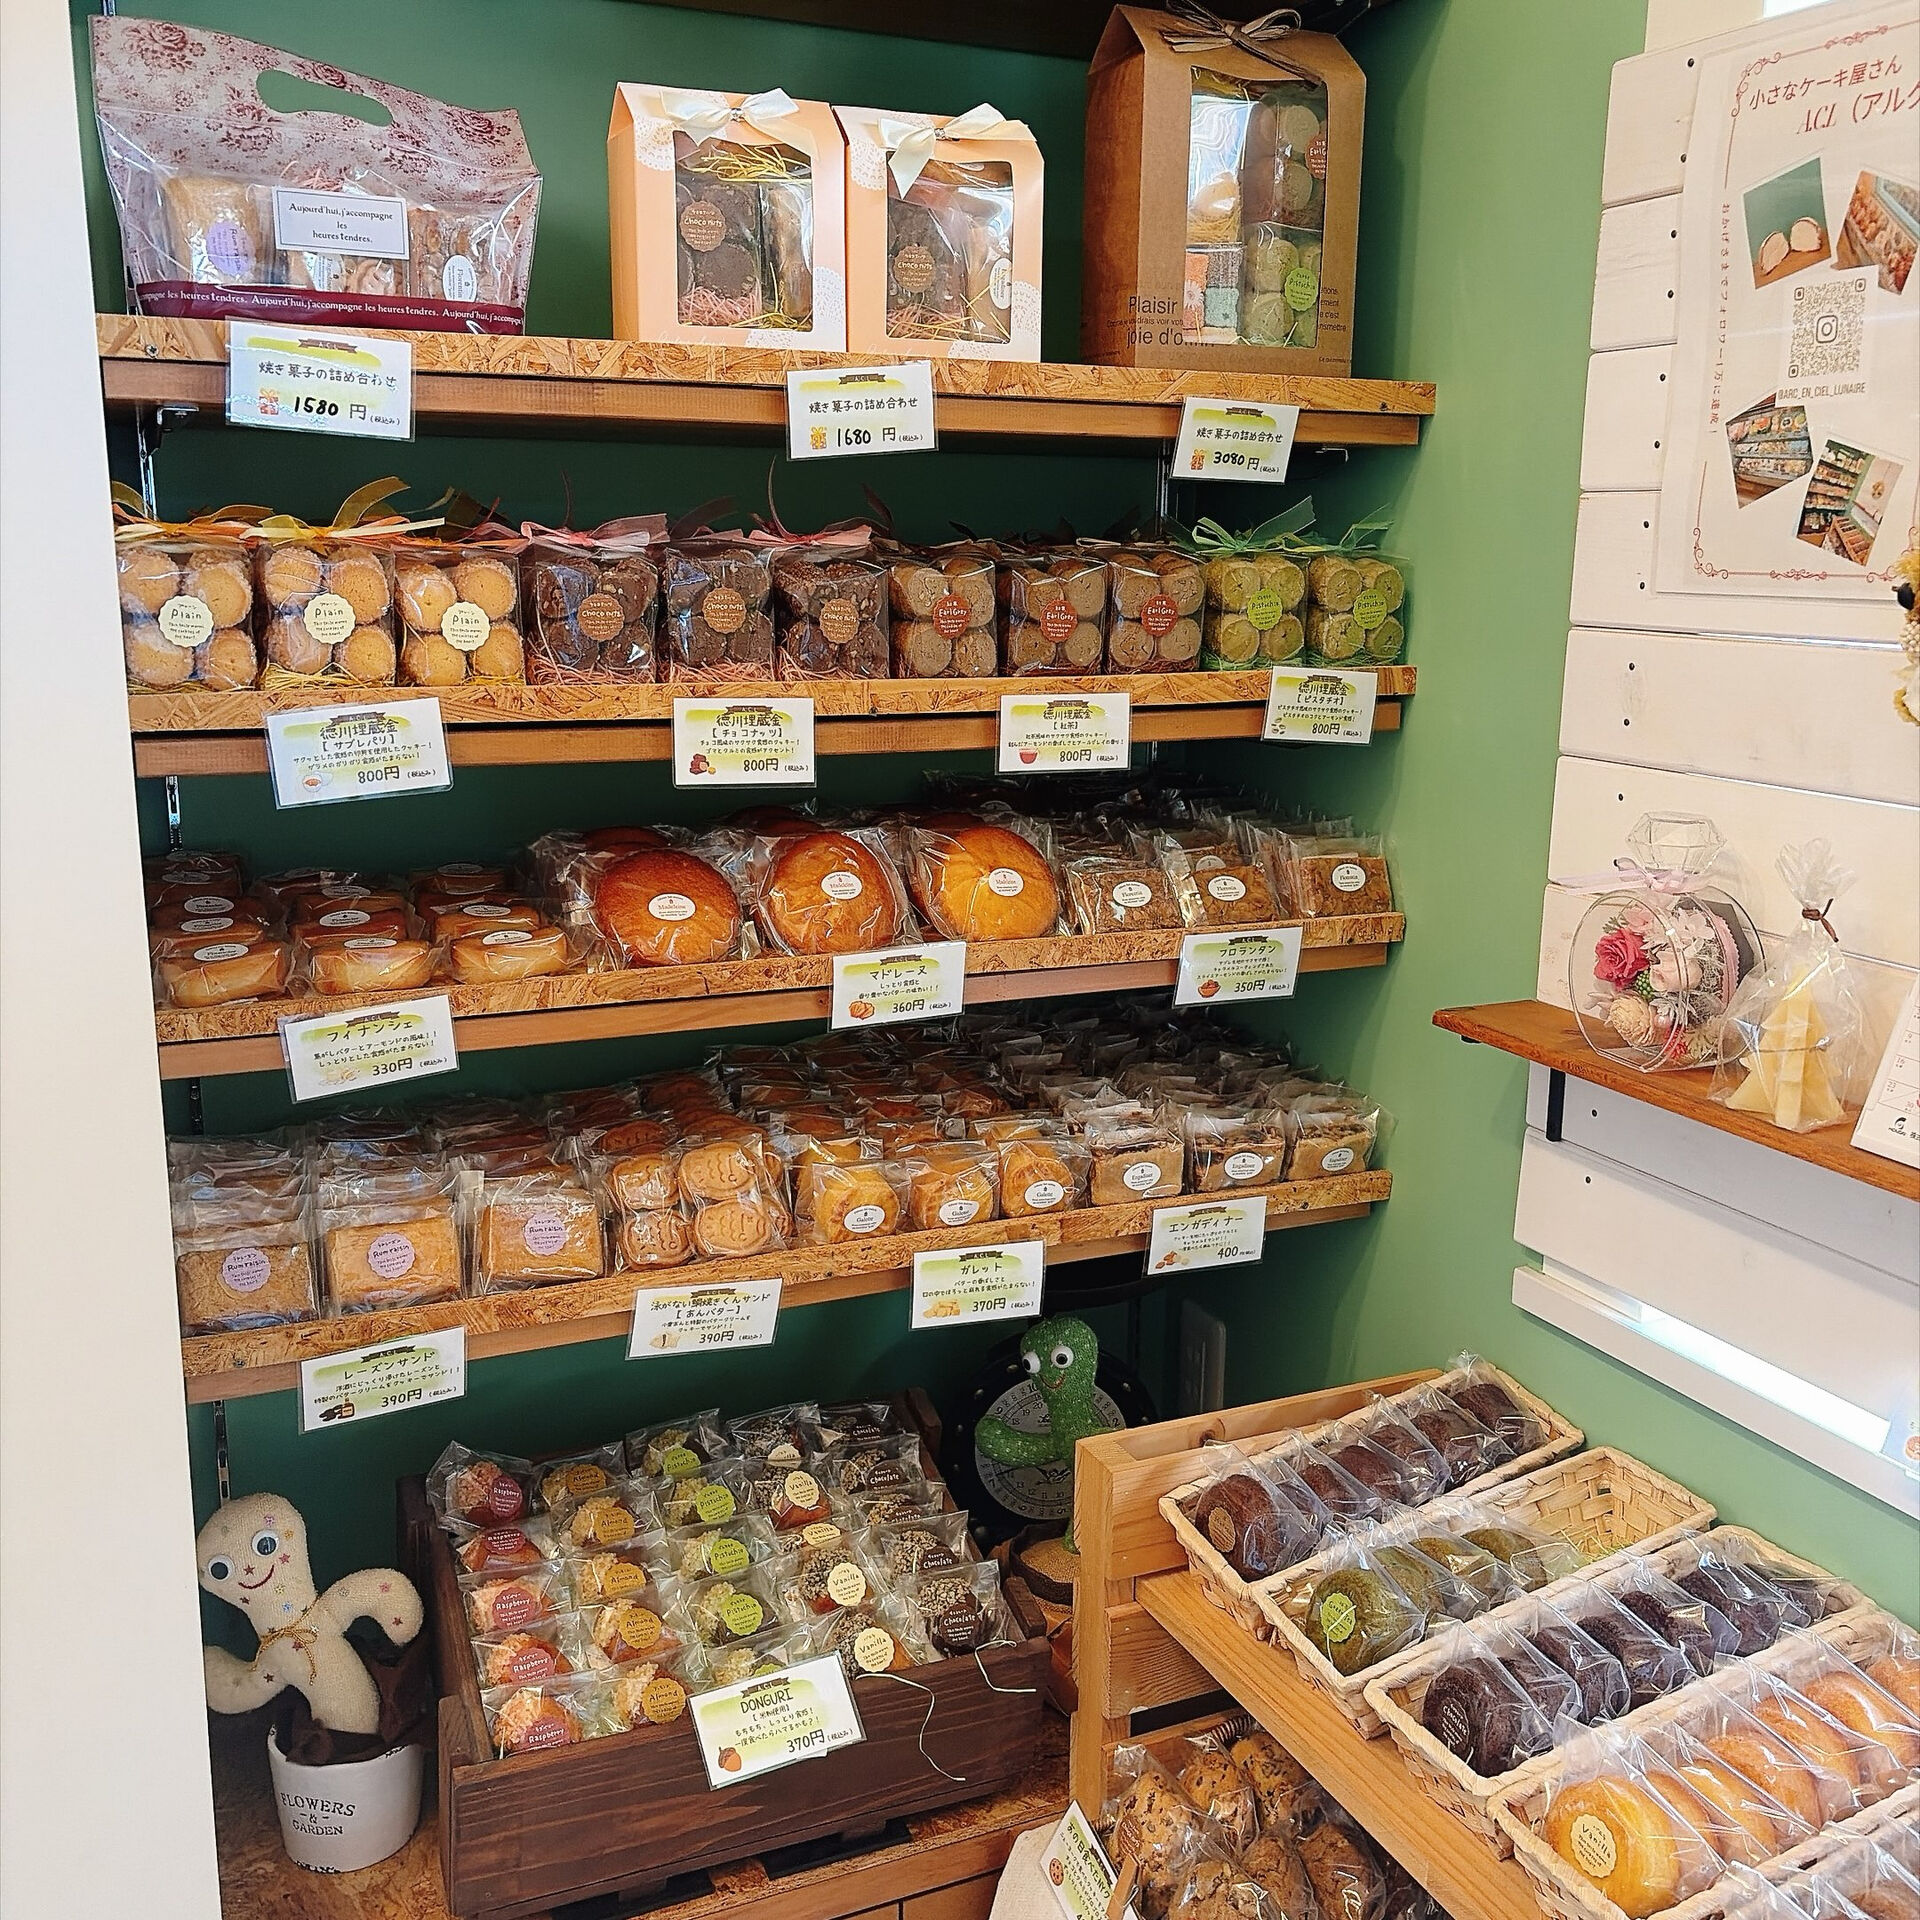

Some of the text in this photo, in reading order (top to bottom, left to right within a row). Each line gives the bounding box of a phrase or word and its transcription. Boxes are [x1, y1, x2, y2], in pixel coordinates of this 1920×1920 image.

[1750, 54, 1902, 110] 小さなケーキ屋さん
[336, 221, 348, 229] les
[312, 230, 373, 243] heures tendres.
[167, 290, 179, 299] les
[180, 290, 210, 301] heures
[210, 292, 248, 303] tendres.
[364, 302, 376, 312] les
[378, 303, 405, 314] heures
[405, 306, 439, 317] tendres.
[1128, 296, 1178, 315] Plaisir
[1126, 326, 1153, 349] joie
[258, 361, 398, 392] 焼き菓子の詰め合わせ
[293, 396, 339, 417] 1580
[349, 403, 367, 421] 円
[809, 397, 918, 414] 焼き菓子の詰め合わせ
[837, 428, 872, 448] 1680
[882, 427, 896, 442] 円
[1196, 427, 1284, 443] 焼き菓子の詰め合わせ
[1213, 451, 1245, 466] 3080
[1246, 457, 1260, 470] 円
[171, 608, 202, 620] Plain
[314, 607, 344, 618] Plain
[452, 614, 480, 625] Plain
[1298, 681, 1350, 696] 徳川埋蔵金
[716, 714, 783, 728] 徳川埋蔵金
[1043, 708, 1094, 721] 徳川埋蔵金
[320, 718, 399, 740] 徳川埋蔵金
[1312, 722, 1340, 735] 800円
[1059, 748, 1092, 763] 800円
[743, 757, 779, 772] 800円
[357, 765, 400, 784] 800円
[1219, 945, 1276, 958] フロランタン
[870, 965, 928, 981] マドレーヌ
[1234, 979, 1266, 993] 350円
[892, 999, 925, 1014] 360円
[327, 1020, 413, 1043] フィナンシェ
[372, 1057, 413, 1077] 330円
[528, 1226, 543, 1234] Rum
[1169, 1215, 1243, 1233] エンガディナー
[372, 1245, 410, 1259] Rum raisin
[1217, 1246, 1239, 1259] 400
[227, 1259, 266, 1272] Rum raisin
[961, 1262, 1002, 1275] ガレット
[972, 1297, 1006, 1312] 370円
[699, 1330, 735, 1344] 390円
[344, 1352, 436, 1380] レーズンサンド
[381, 1388, 423, 1408] 390円
[852, 1425, 881, 1437] Chocolate
[789, 1478, 813, 1490] Vanilla
[869, 1473, 900, 1485] Chocolate
[699, 1492, 729, 1509] Pistachio
[600, 1517, 628, 1527] Almond
[807, 1526, 834, 1537] Vanilla
[714, 1548, 744, 1560] Pistachio
[923, 1556, 953, 1570] Chocolate
[610, 1574, 639, 1585] Almond
[832, 1573, 860, 1586] Vanilla
[495, 1597, 531, 1611] Raspberry
[726, 1602, 757, 1616] Pistachio
[626, 1616, 655, 1628] Almond
[943, 1612, 976, 1627] Chocolate
[858, 1636, 887, 1654] Vanilla
[513, 1656, 549, 1673] Raspberry
[649, 1689, 679, 1703] Almond
[740, 1687, 794, 1714] DONGURI
[528, 1727, 565, 1744] Raspberry
[786, 1728, 825, 1753] 370円
[280, 1792, 356, 1817] FLOWERS
[292, 1819, 343, 1836] GARDEN
[1581, 1824, 1612, 1859] Vanilla
